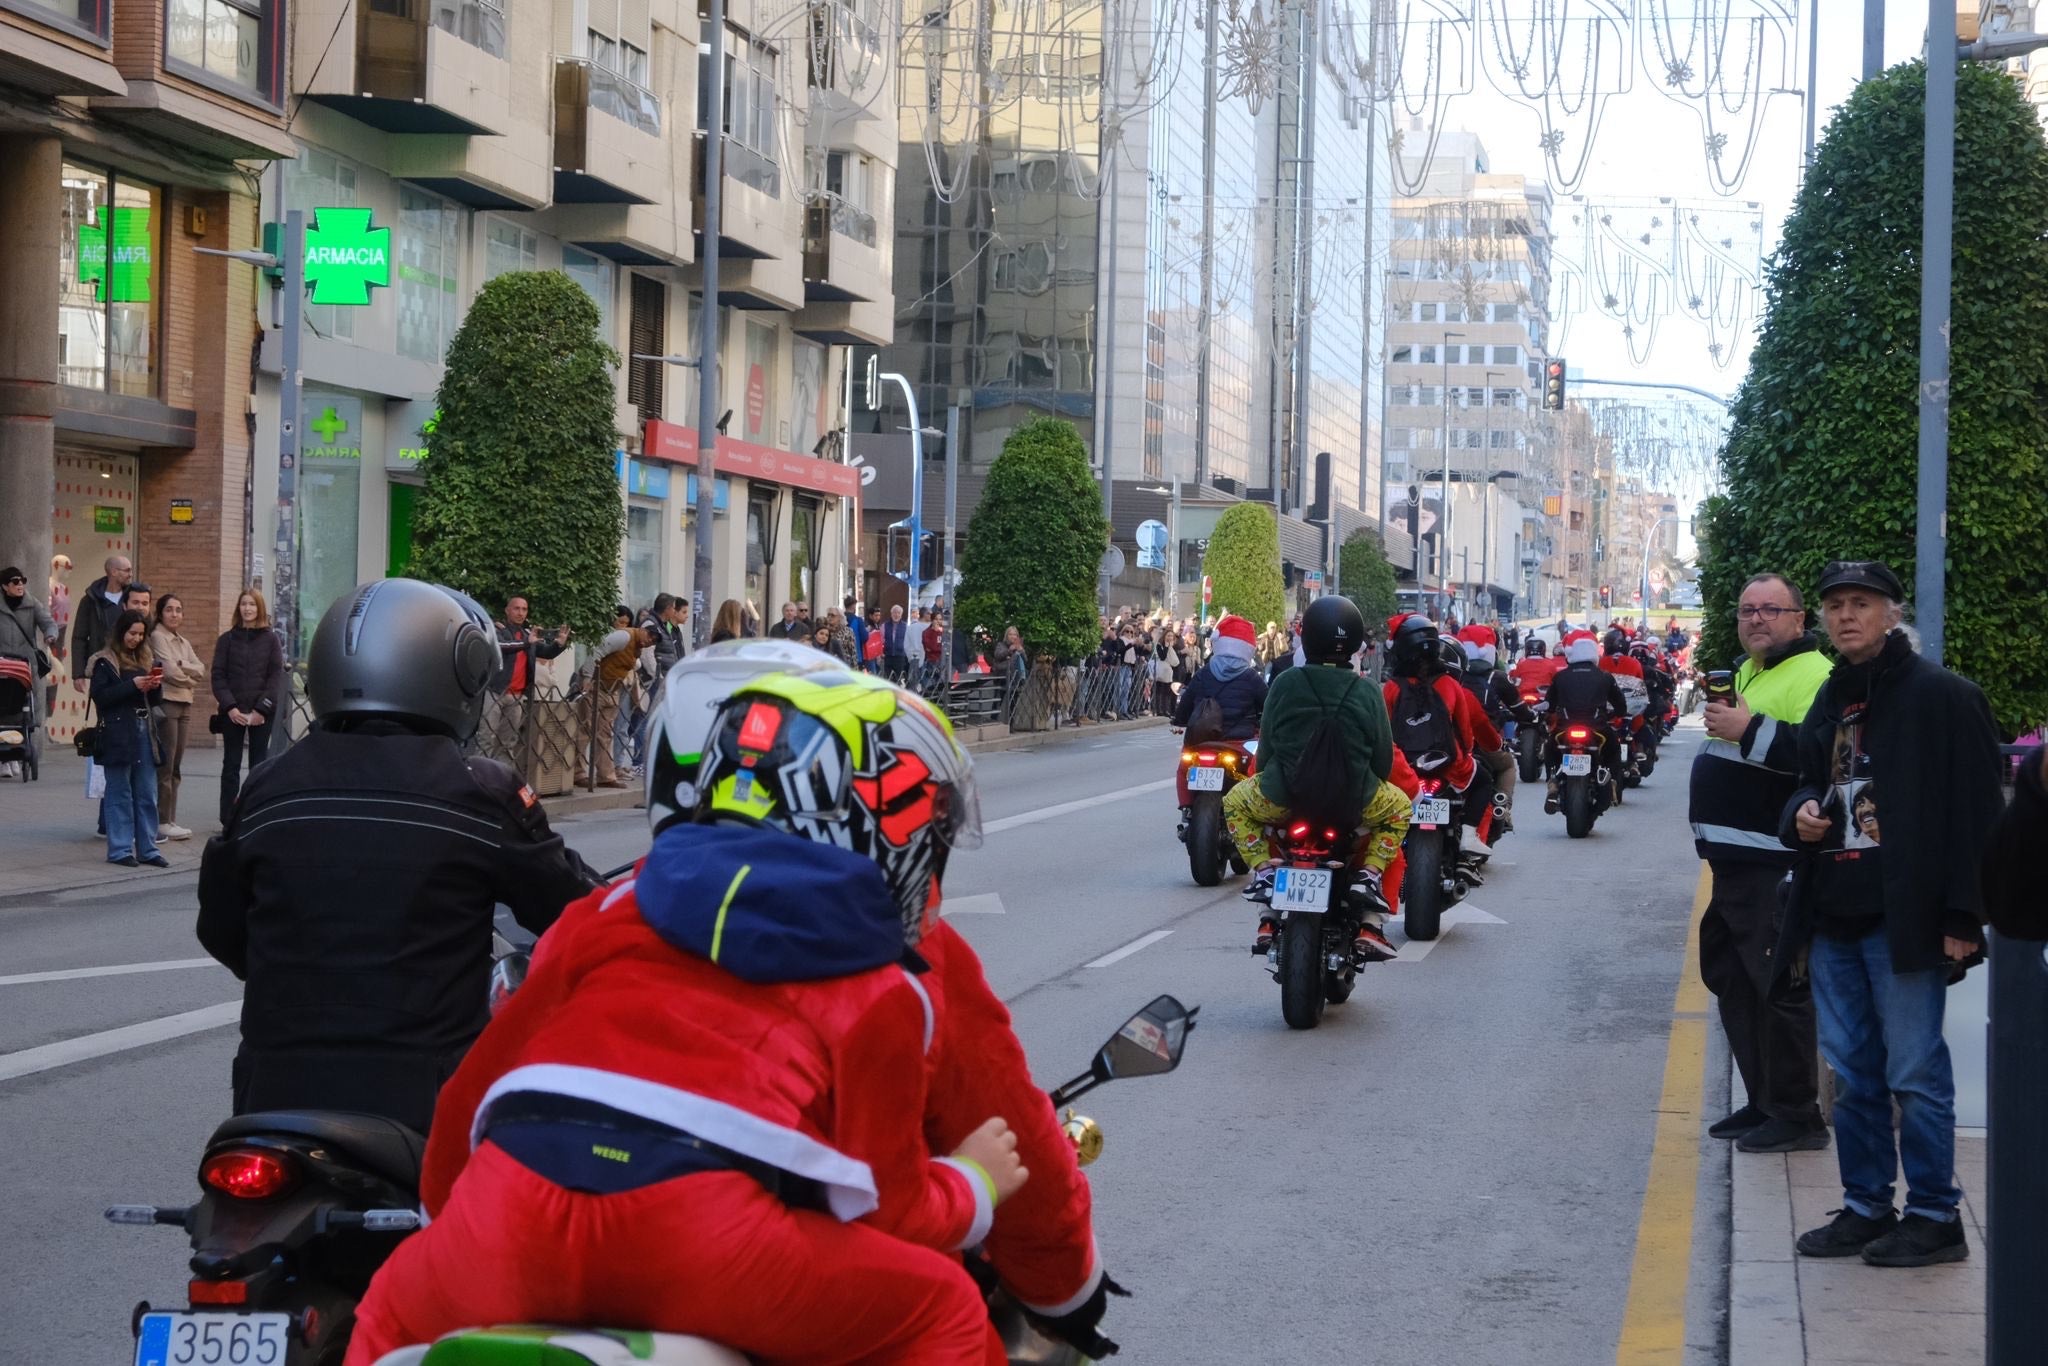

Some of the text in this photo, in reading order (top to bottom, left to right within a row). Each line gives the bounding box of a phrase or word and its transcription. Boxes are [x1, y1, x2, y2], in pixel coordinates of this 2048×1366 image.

[305, 247, 385, 265] ARMACIA
[1417, 811, 1439, 822] MRV
[1291, 872, 1327, 888] 1922
[1286, 888, 1315, 903] MWJ
[174, 1321, 278, 1364] 3565
